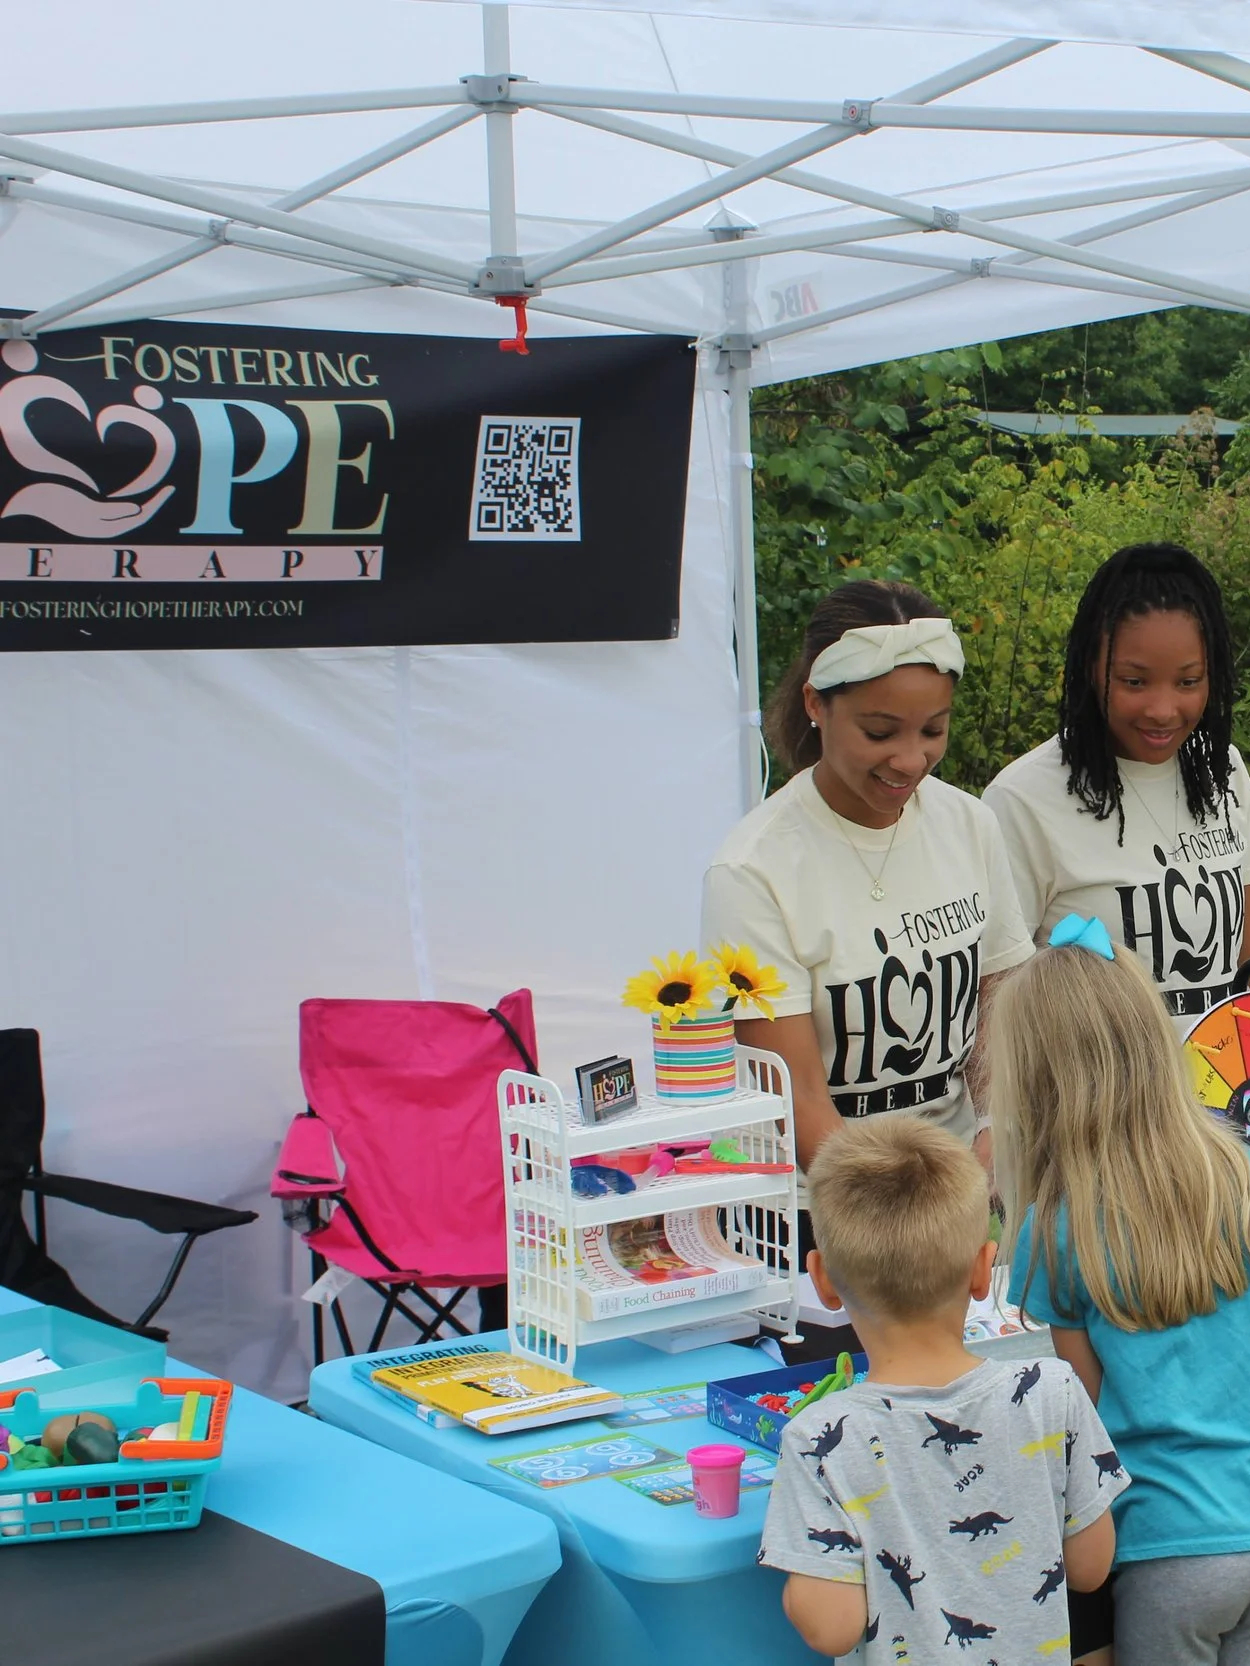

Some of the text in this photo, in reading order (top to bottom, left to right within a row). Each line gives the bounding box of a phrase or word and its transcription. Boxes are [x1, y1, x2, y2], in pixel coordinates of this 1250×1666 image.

[44, 336, 380, 388] FOSTERING
[0, 372, 395, 538] OPE
[26, 548, 378, 579] ERAPY
[889, 892, 985, 948] FOSTERING
[1115, 846, 1244, 983] HOP
[592, 1074, 632, 1105] HOPE
[830, 1073, 950, 1117] HERA
[624, 1293, 650, 1308] Food
[652, 1287, 696, 1302] Chaining
[367, 1344, 489, 1368] INTEGRATING
[390, 1353, 507, 1377] INTEGRATING
[954, 1463, 984, 1493] ROAR
